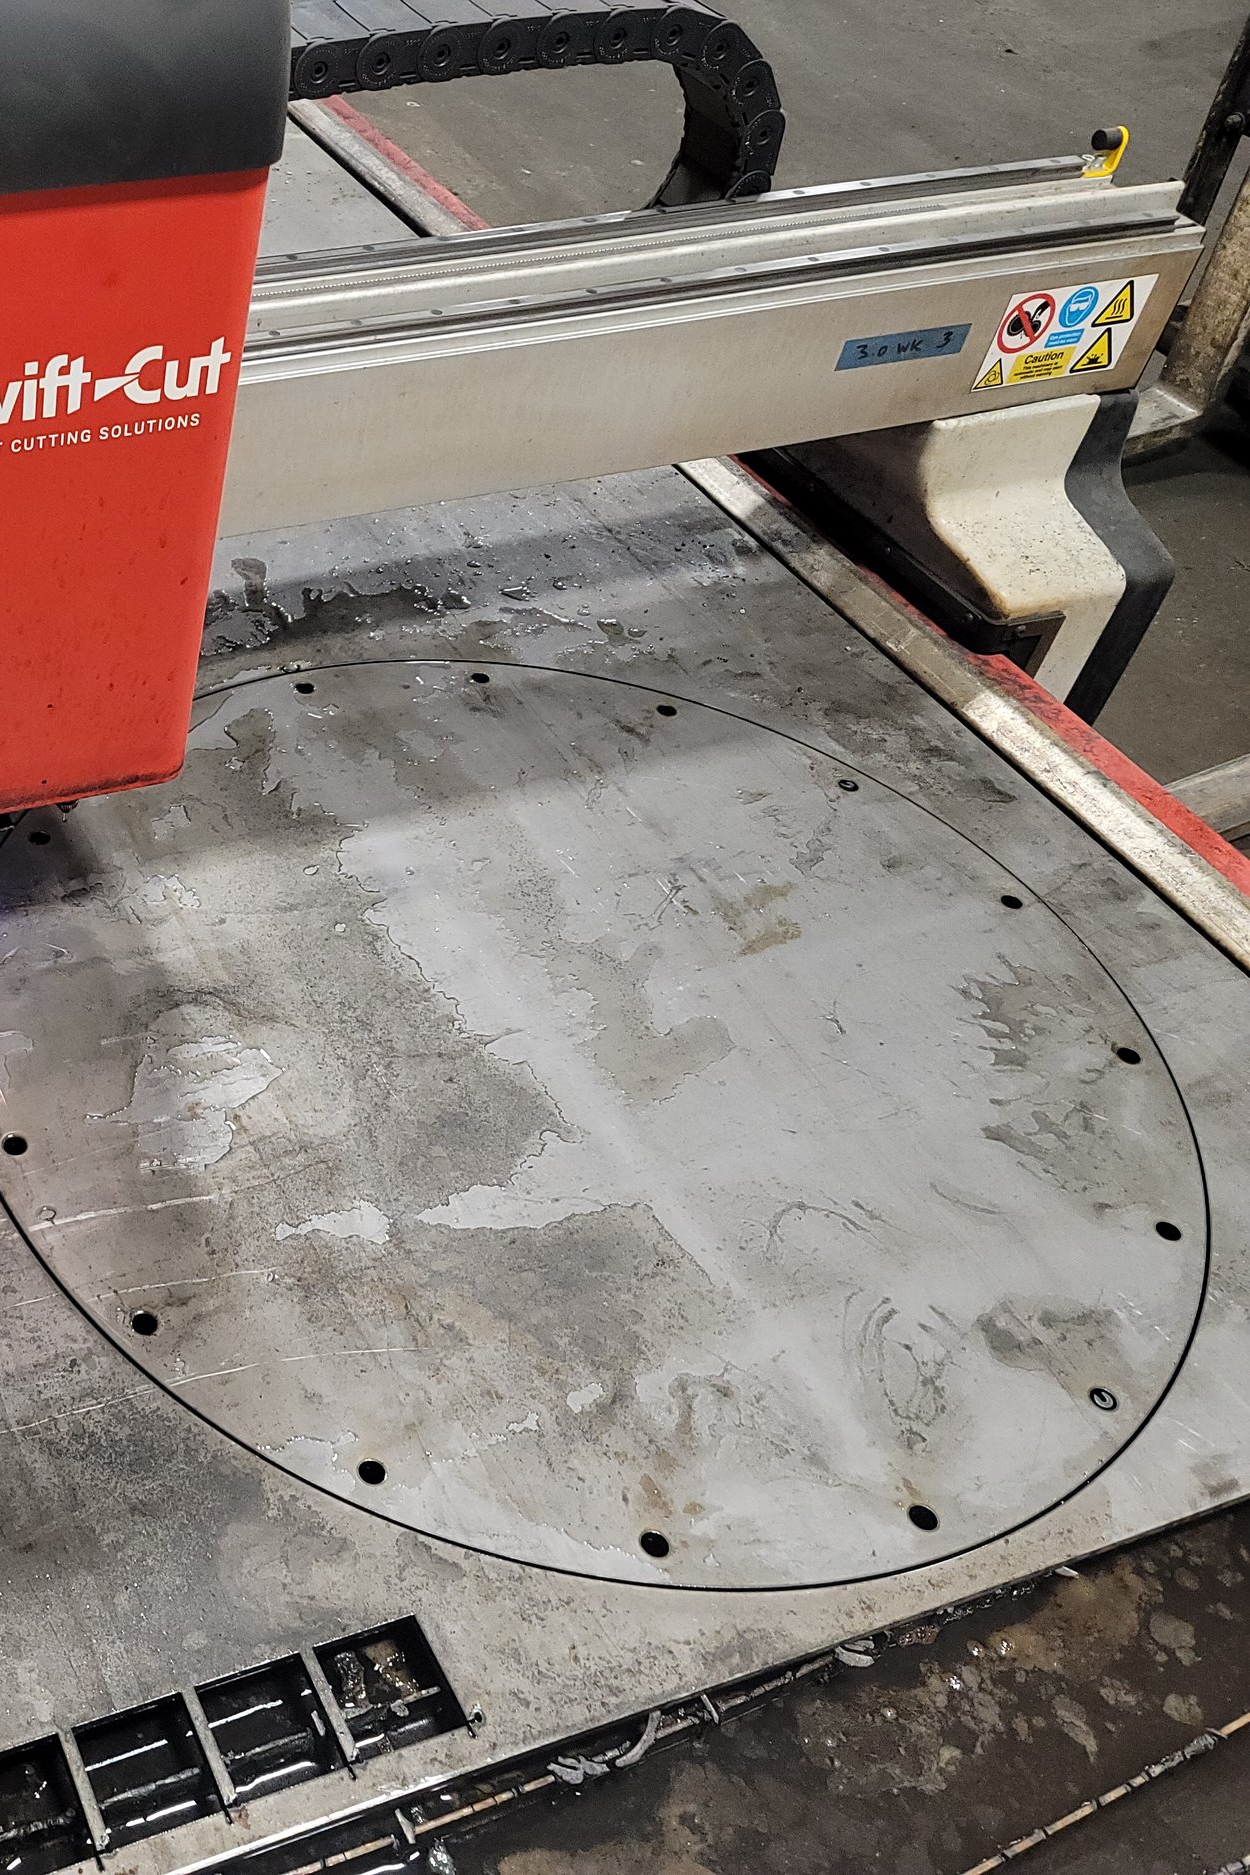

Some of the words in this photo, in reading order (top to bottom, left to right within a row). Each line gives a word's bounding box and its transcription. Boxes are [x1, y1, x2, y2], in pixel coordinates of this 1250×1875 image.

[897, 339, 923, 353] WK
[936, 331, 954, 349] 3
[1024, 351, 1064, 364] Caution
[11, 429, 92, 453] CUTTING
[99, 413, 201, 440] SOLUTIONS
